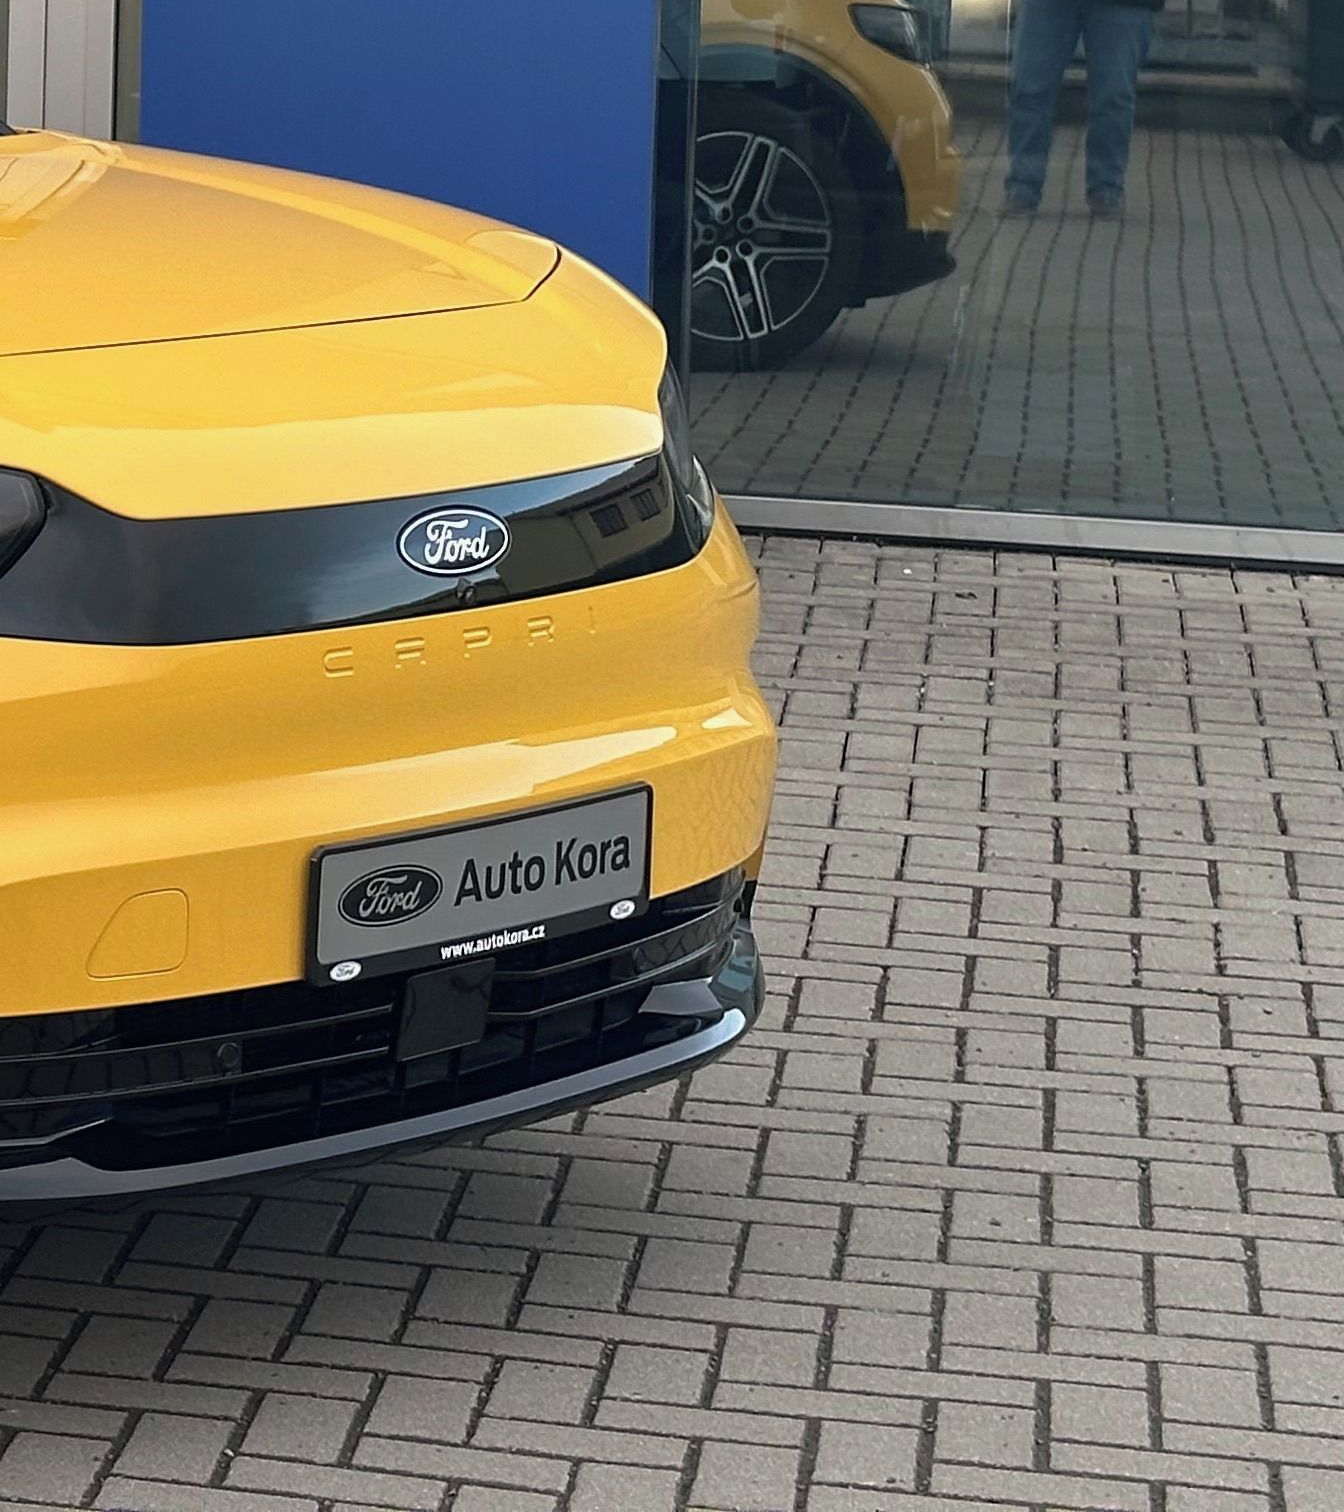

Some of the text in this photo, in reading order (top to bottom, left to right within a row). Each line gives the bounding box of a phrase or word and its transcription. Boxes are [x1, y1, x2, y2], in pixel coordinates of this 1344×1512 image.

[424, 520, 489, 564] Ford
[323, 605, 596, 678] CAPRI
[359, 836, 630, 917] Ford Auto Kora
[440, 924, 546, 960] www.autokora.cz
